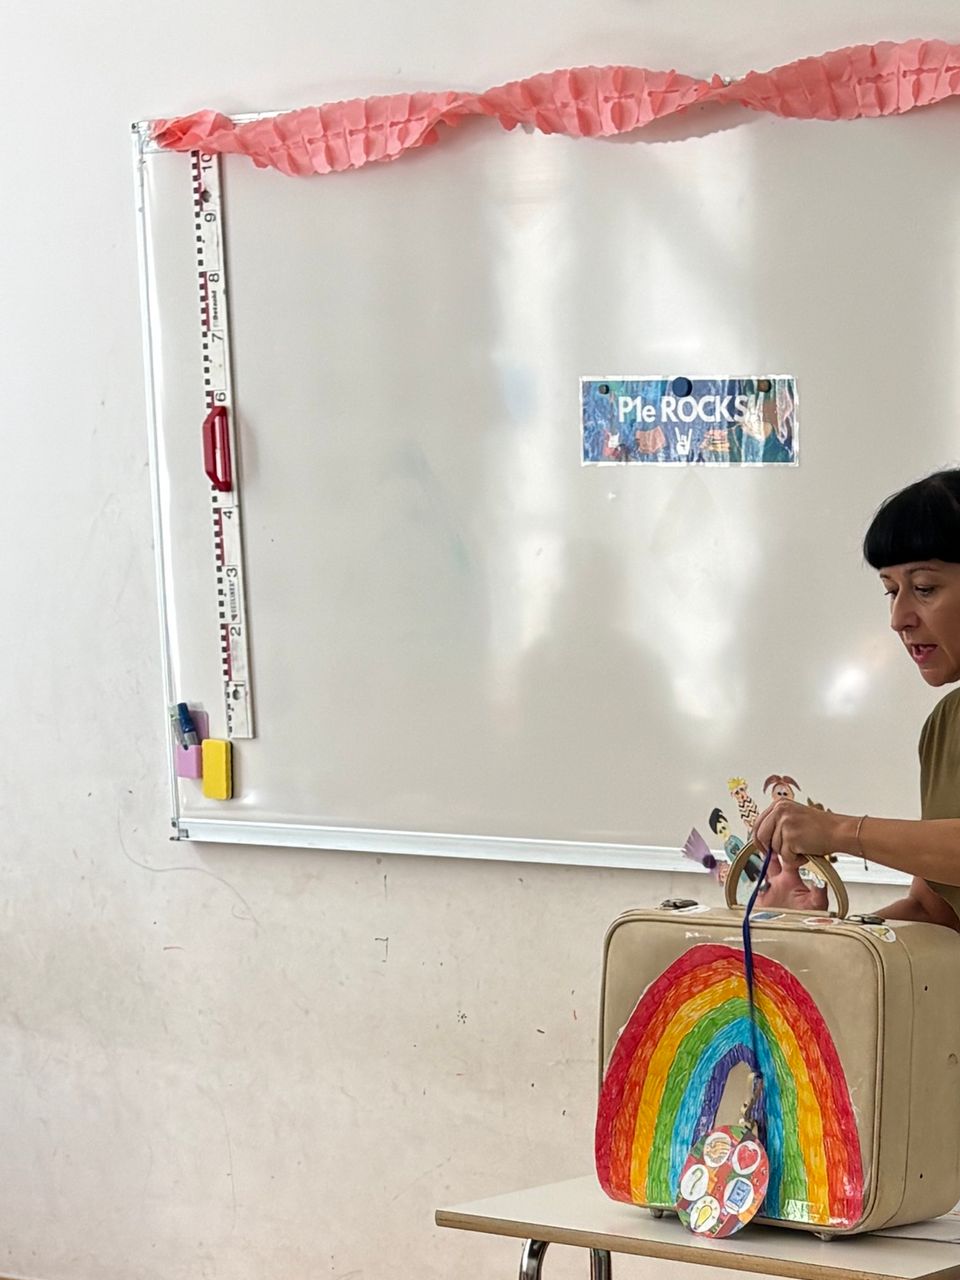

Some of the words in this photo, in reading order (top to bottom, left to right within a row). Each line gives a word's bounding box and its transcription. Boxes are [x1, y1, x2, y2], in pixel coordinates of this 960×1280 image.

[205, 212, 216, 223] 9
[209, 272, 220, 283] 8
[211, 332, 224, 343] 7
[216, 391, 227, 402] 6
[618, 396, 656, 423] P1e
[222, 510, 233, 520] 4
[227, 568, 238, 578] 3
[231, 626, 242, 636] 2
